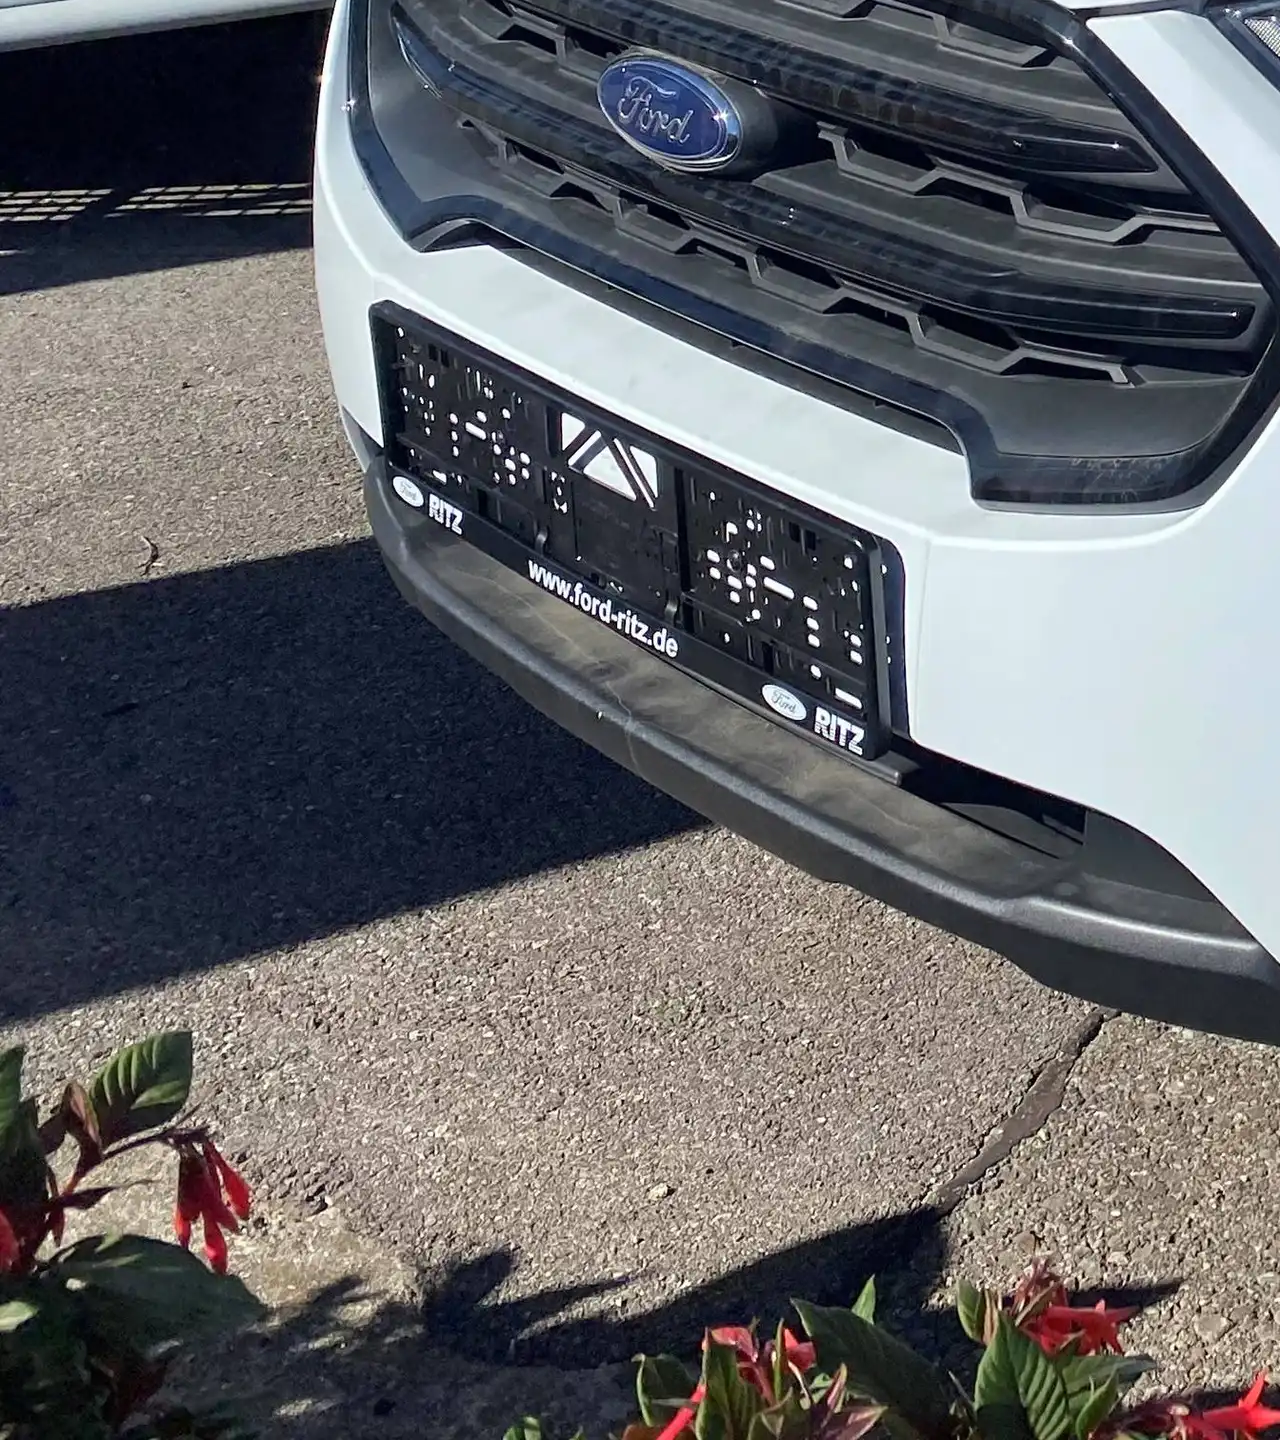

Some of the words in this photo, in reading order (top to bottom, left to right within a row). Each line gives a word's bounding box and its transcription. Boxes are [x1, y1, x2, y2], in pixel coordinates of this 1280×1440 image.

[617, 76, 694, 144] Ford
[429, 493, 463, 535] RITZ
[528, 560, 679, 658] www.ford-ritz.de
[814, 706, 865, 756] RITZ
